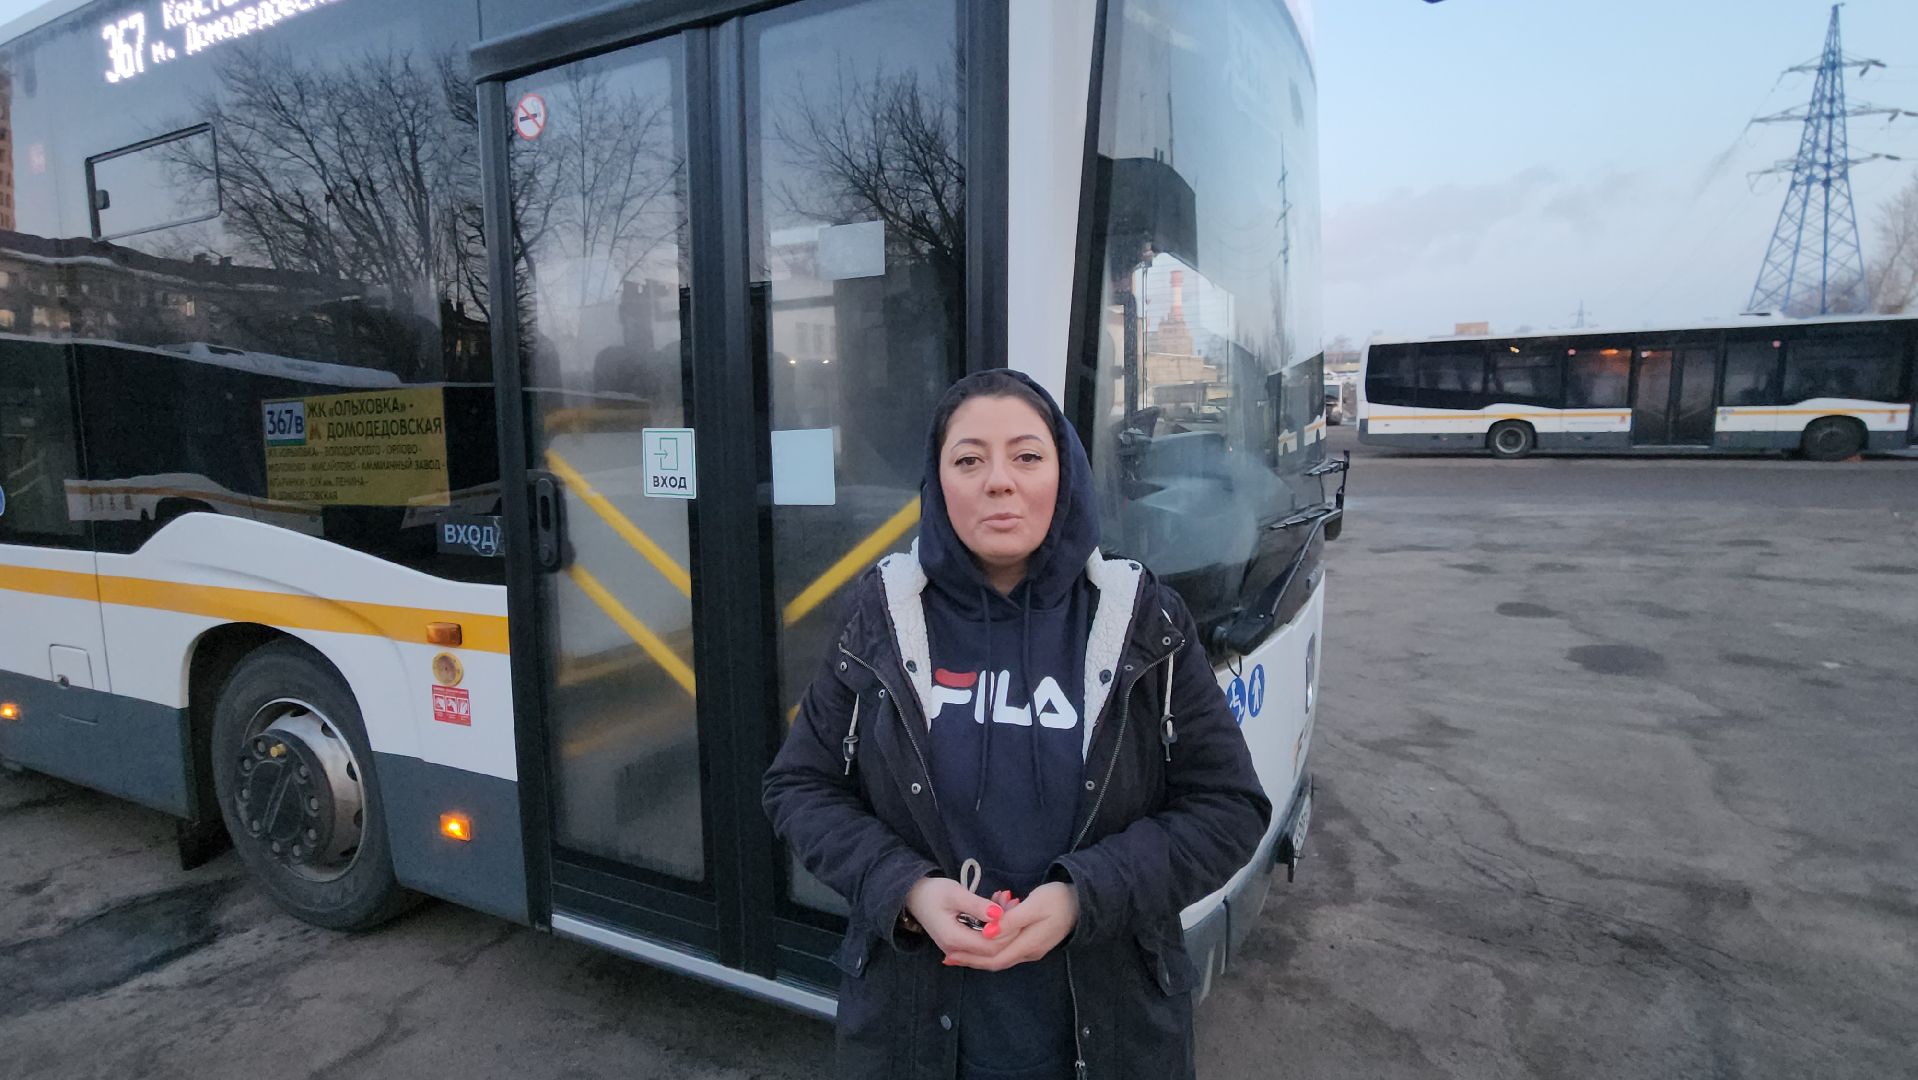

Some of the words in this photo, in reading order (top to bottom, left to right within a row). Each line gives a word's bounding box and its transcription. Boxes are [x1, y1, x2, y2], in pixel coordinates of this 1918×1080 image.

[102, 12, 145, 83] 367
[307, 402, 327, 418] ЖК
[327, 417, 442, 441] ДОМОДЕДОВСКАЯ
[652, 475, 687, 490] ВХОД
[444, 524, 495, 550] ВХОД
[930, 668, 1078, 730] FILA
